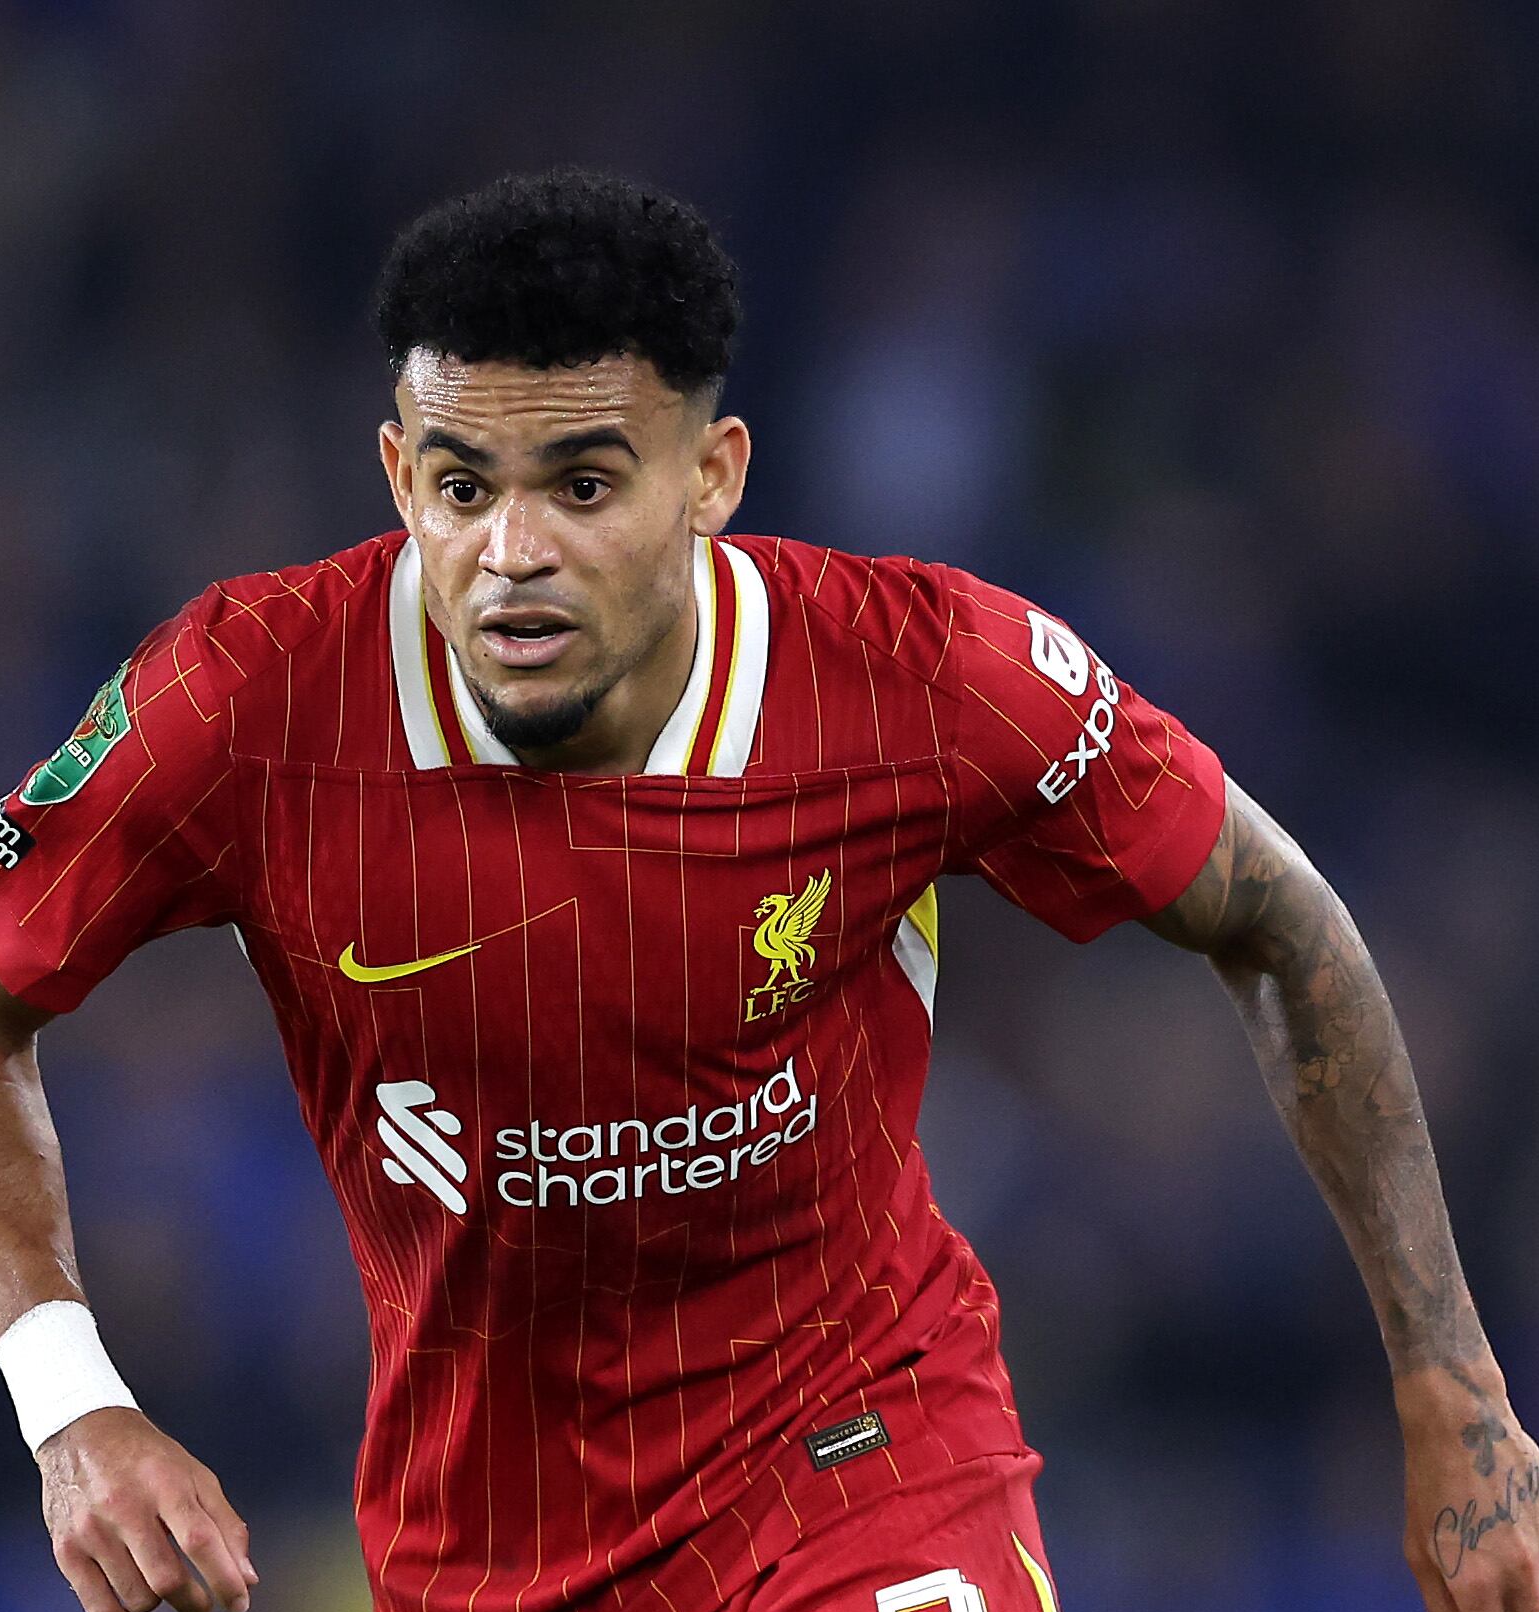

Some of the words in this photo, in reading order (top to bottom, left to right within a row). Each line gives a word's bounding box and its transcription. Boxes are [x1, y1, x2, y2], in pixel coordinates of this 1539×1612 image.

[1037, 646, 1120, 804] Expe
[496, 1056, 801, 1162] standard
[497, 1095, 817, 1207] chartered
